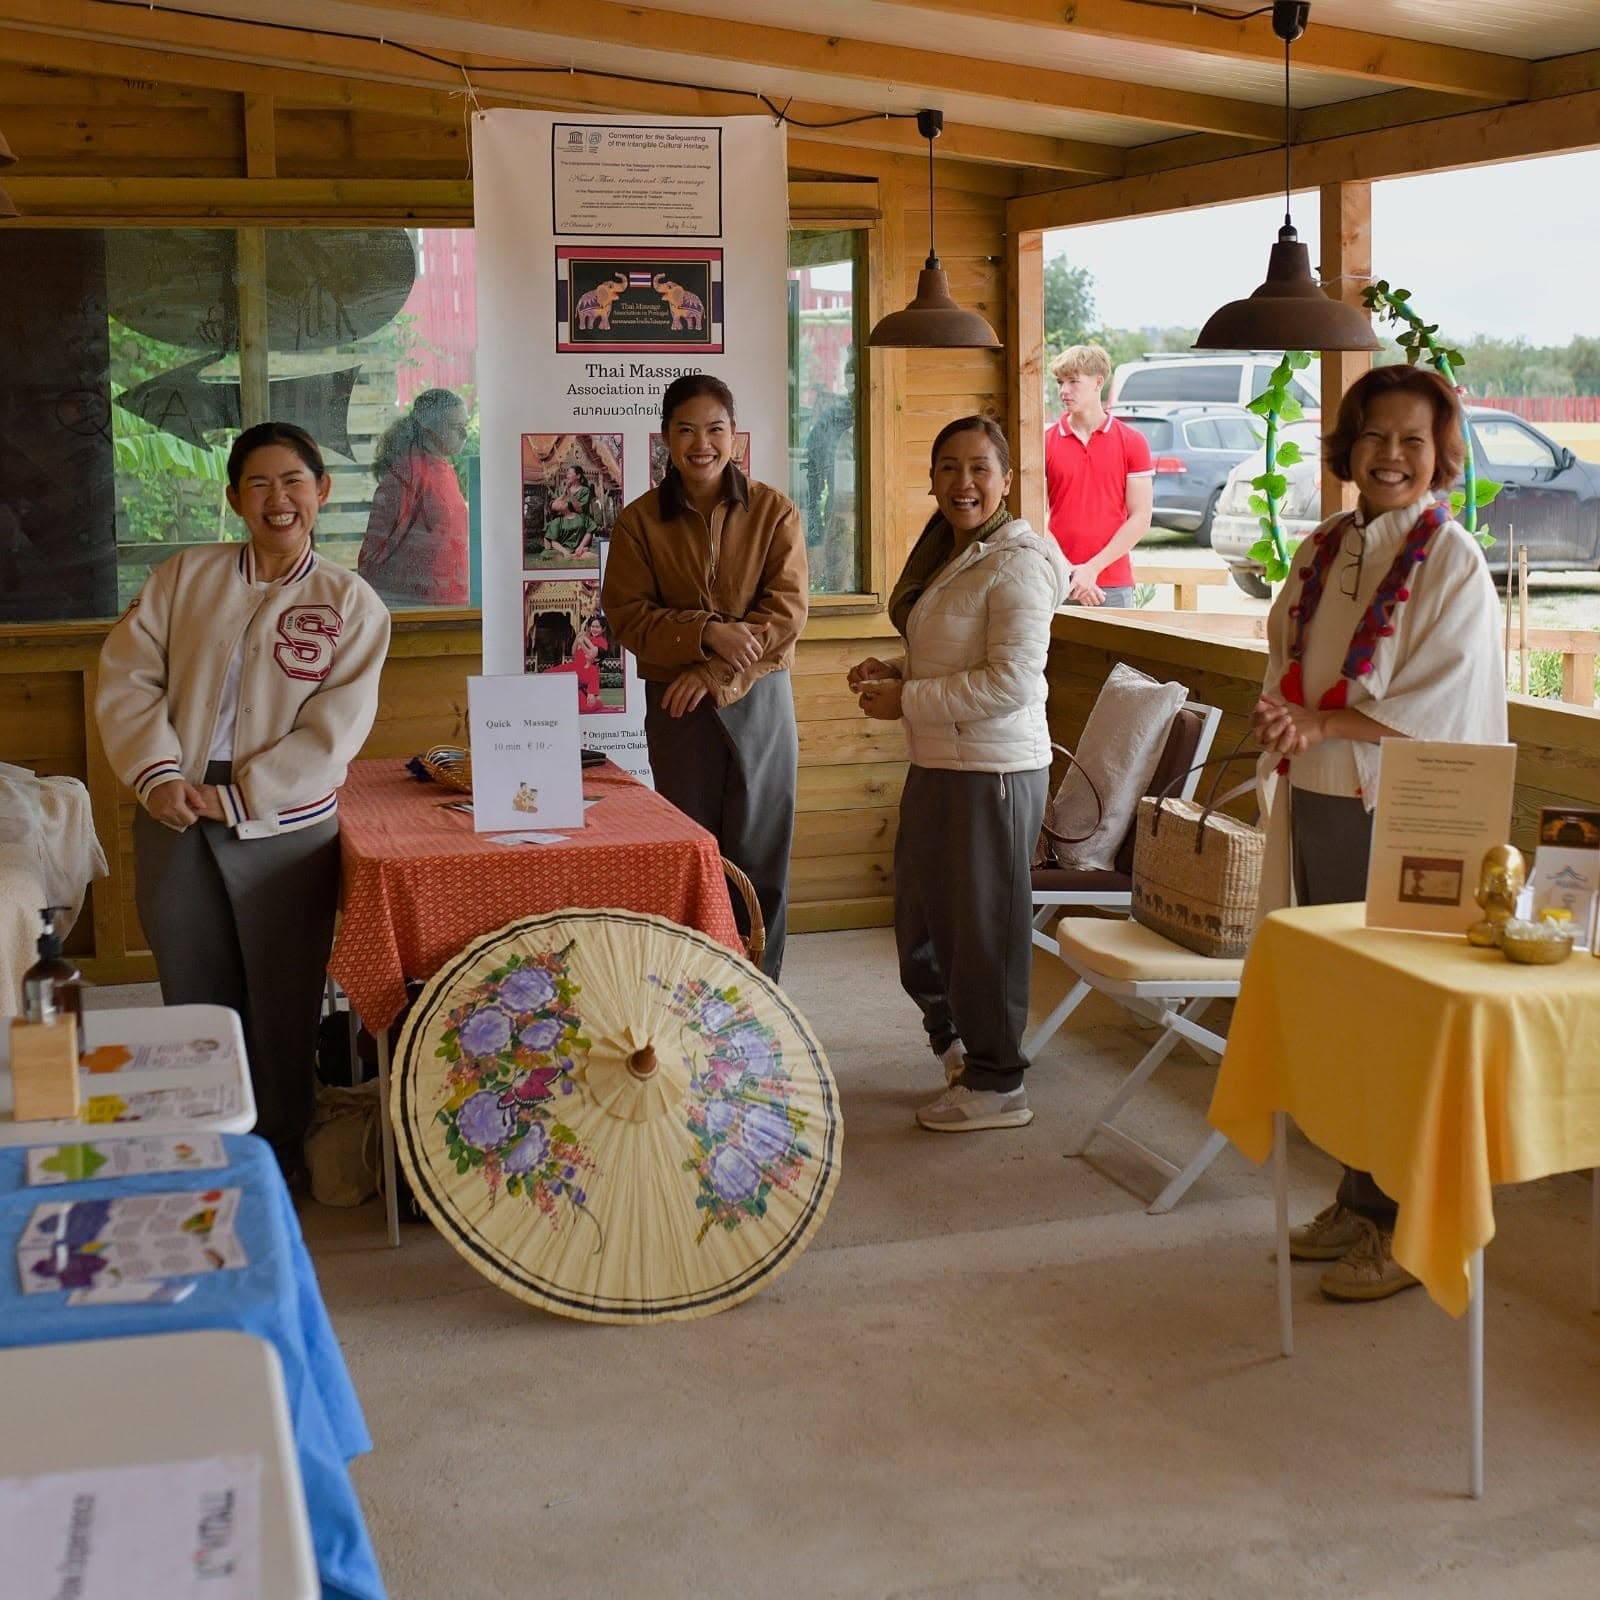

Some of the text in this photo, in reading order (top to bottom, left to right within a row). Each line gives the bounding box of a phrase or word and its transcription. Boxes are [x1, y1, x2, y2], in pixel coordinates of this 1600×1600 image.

[608, 132, 643, 140] Convention
[666, 134, 706, 142] Safeguarding
[628, 141, 657, 149] Intangible
[658, 141, 682, 149] Cultural
[683, 143, 710, 151] Heritage
[585, 363, 625, 378] Thai
[567, 383, 644, 395] Association
[648, 384, 660, 395] in
[273, 604, 344, 682] S
[486, 719, 559, 729] Quick Massage
[588, 731, 620, 740] Original
[494, 743, 504, 752] 10
[588, 743, 626, 751] Carvoeiro
